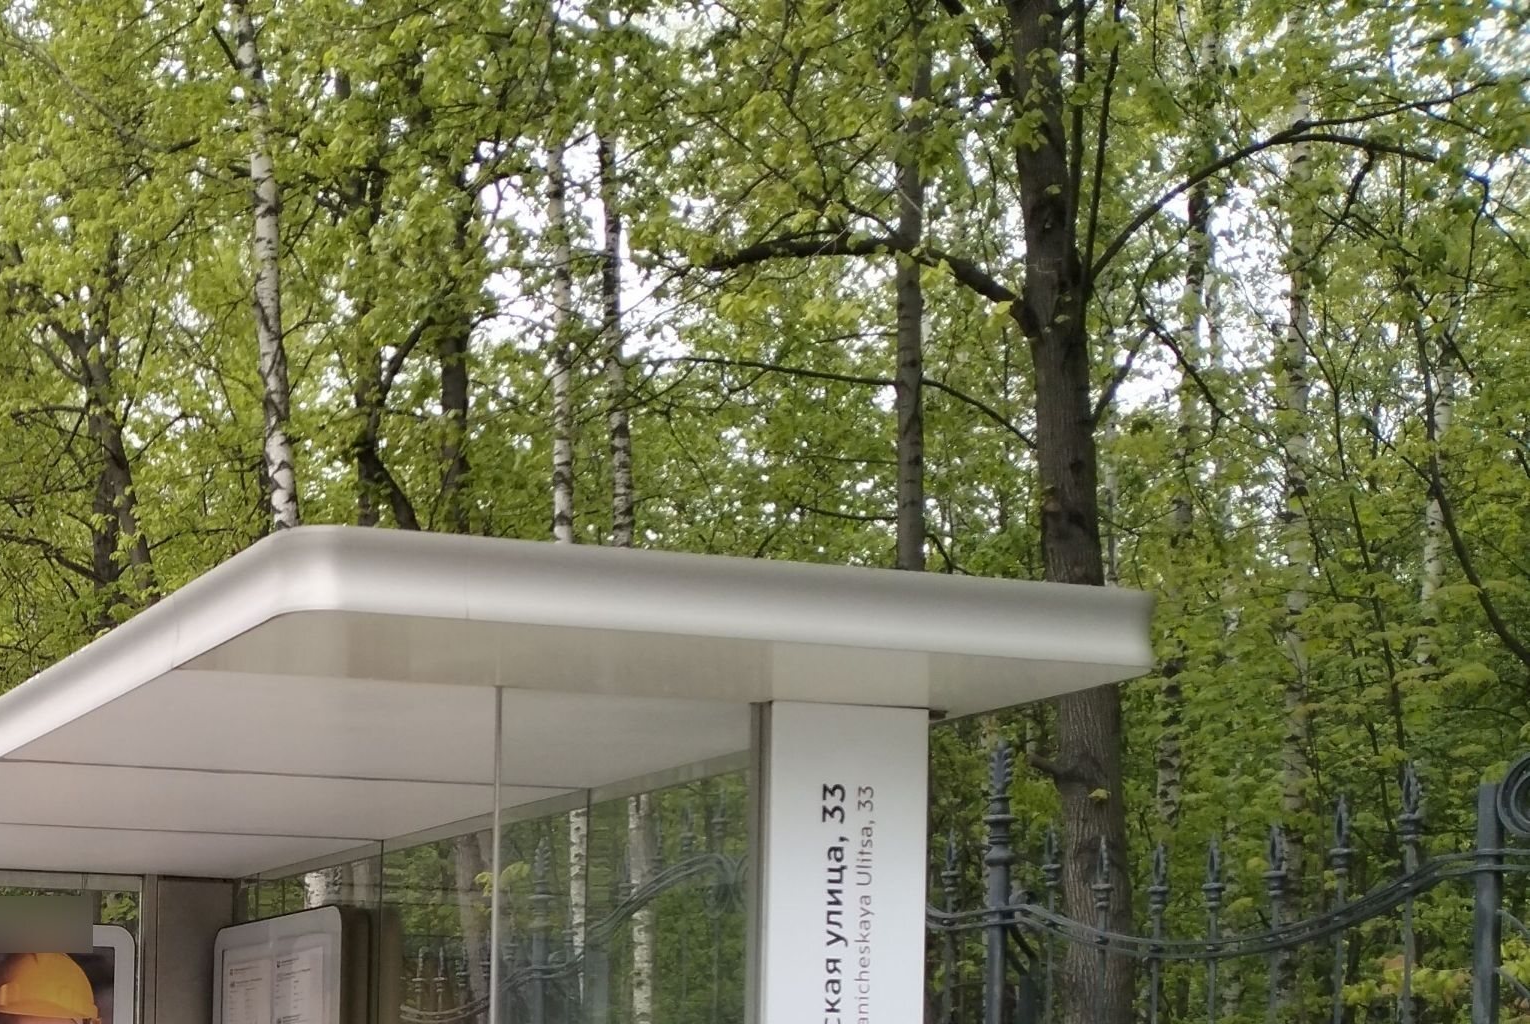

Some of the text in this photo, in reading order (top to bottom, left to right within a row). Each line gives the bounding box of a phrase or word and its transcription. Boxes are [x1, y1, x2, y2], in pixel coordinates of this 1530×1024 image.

[821, 783, 846, 824] 33
[857, 785, 874, 812] 33
[856, 820, 875, 886] Ulitsa,
[825, 836, 849, 947] улица,
